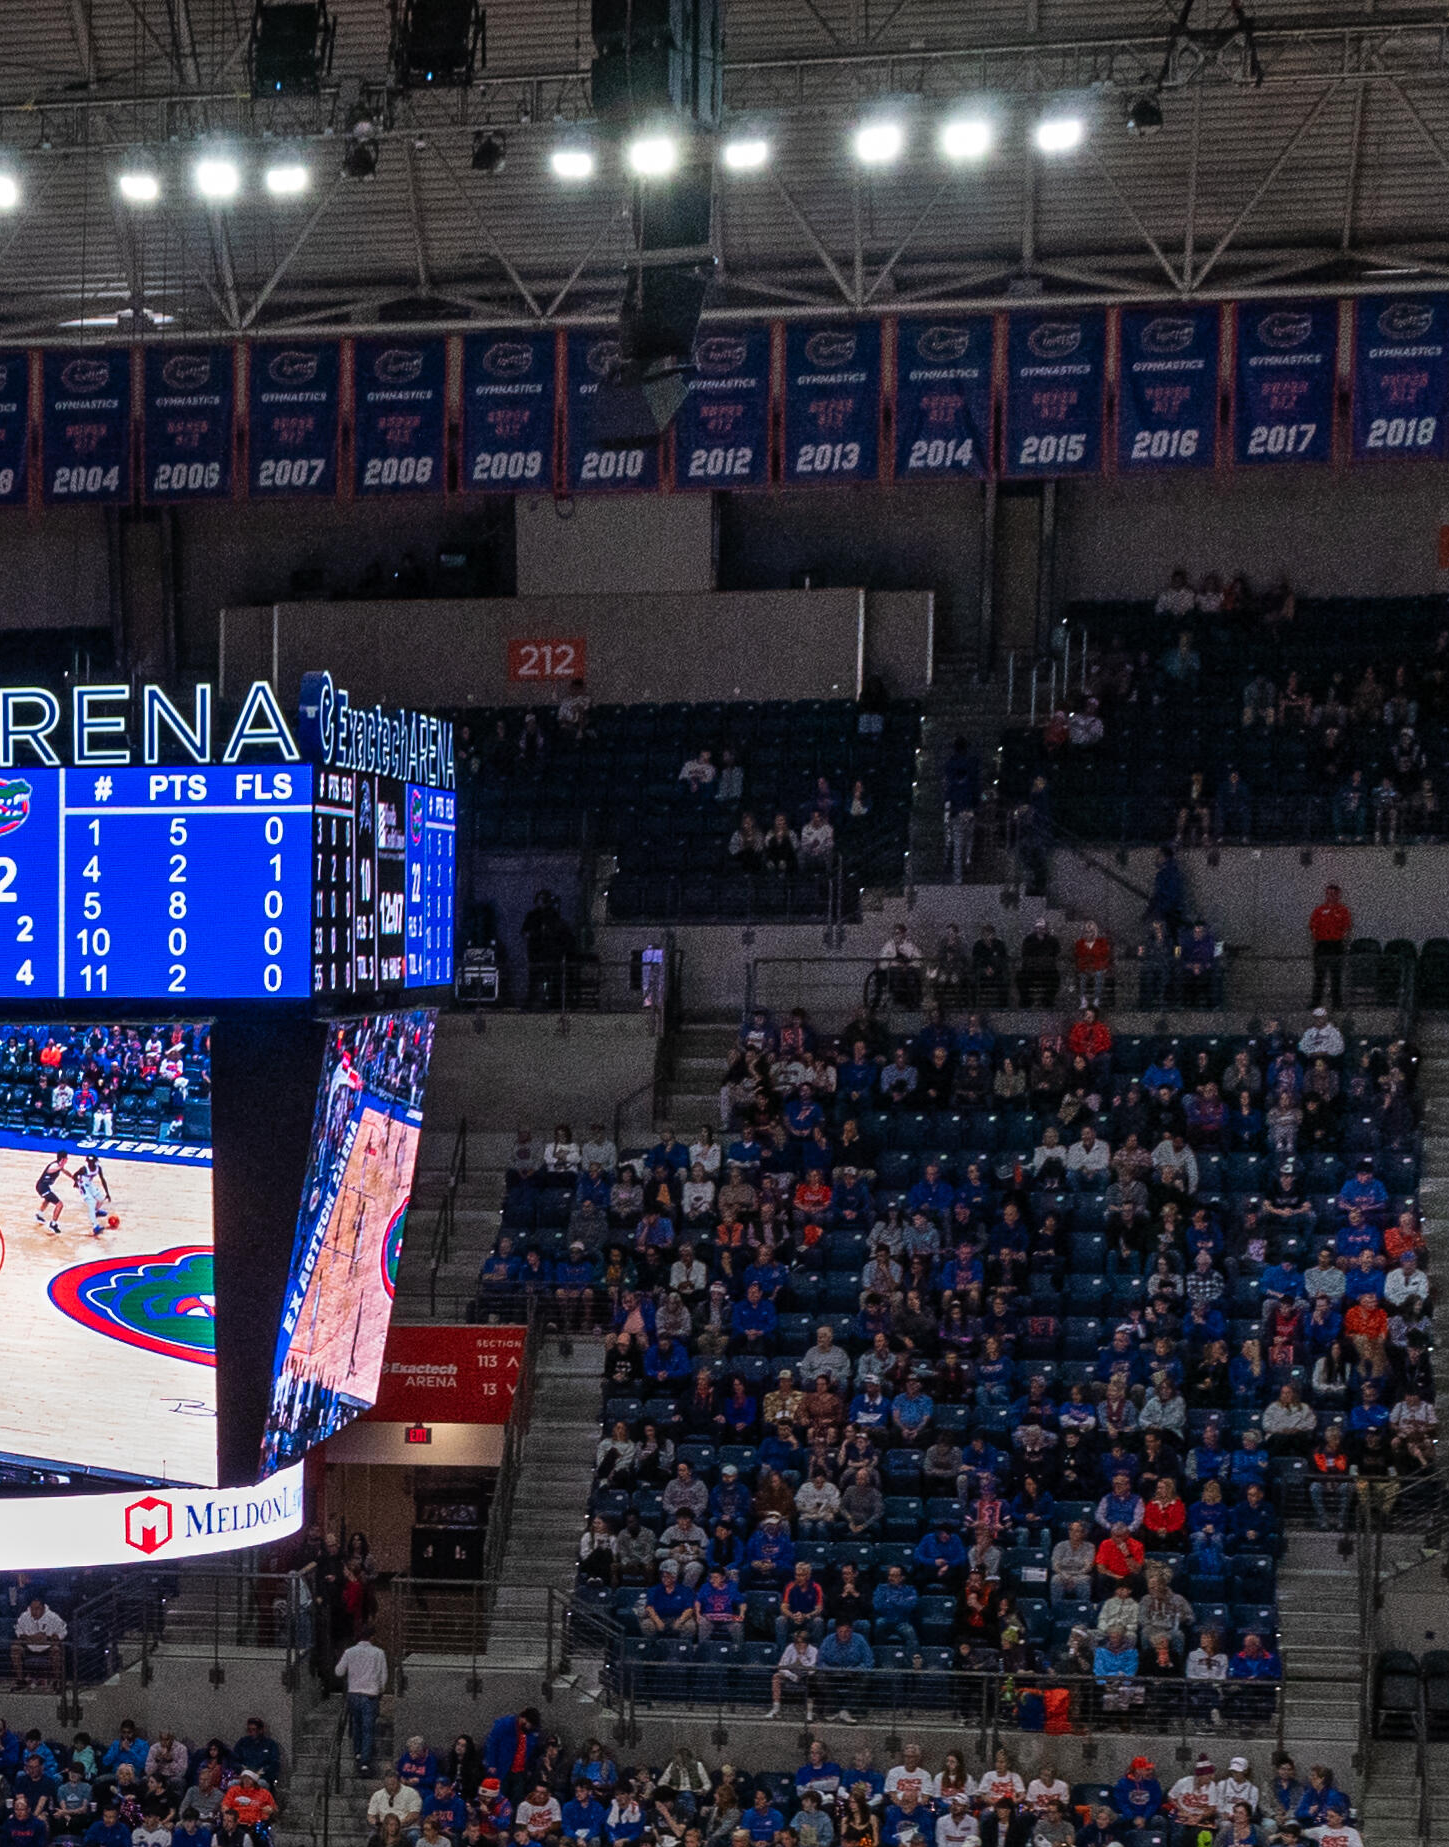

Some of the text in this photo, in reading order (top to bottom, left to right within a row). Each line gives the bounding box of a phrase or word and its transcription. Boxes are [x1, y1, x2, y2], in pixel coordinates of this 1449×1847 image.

[1132, 430, 1197, 459] 2016
[1367, 417, 1436, 447] 2018
[473, 452, 542, 479] 2009
[797, 443, 860, 471] 2013
[909, 439, 973, 467] 2014
[53, 467, 119, 493] 2004
[259, 460, 325, 486] 2007
[518, 645, 576, 676] 212
[95, 773, 292, 801] # PTS FLS
[17, 916, 33, 941] 2
[16, 959, 34, 985] 4
